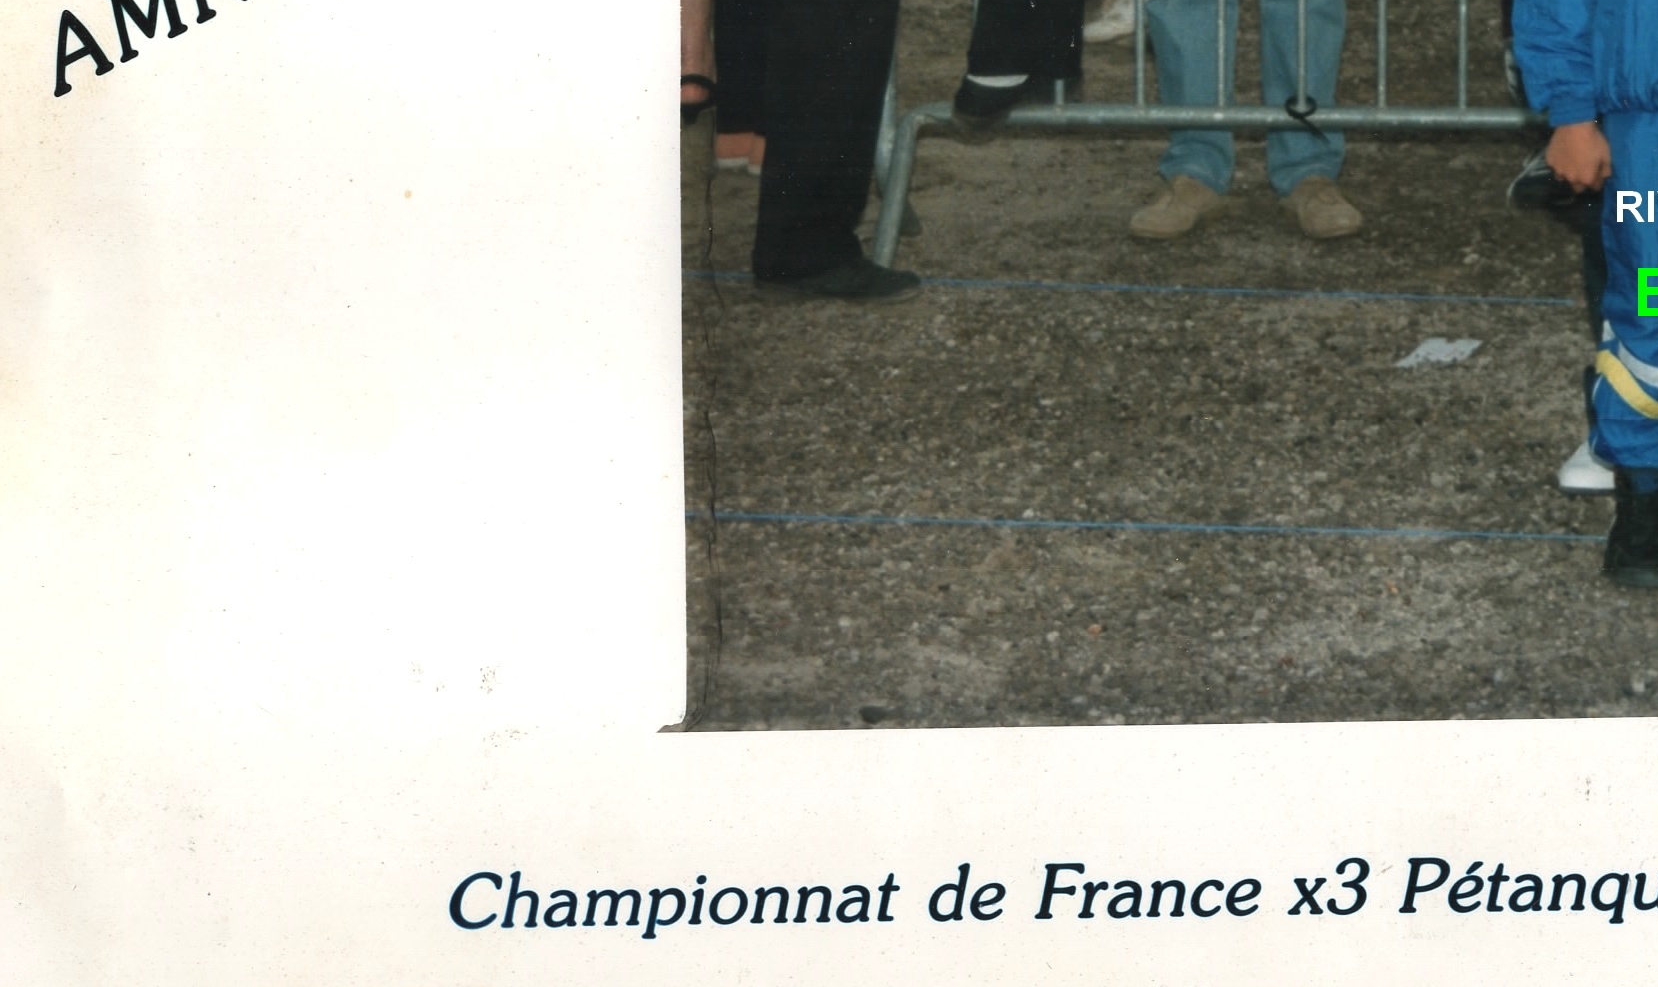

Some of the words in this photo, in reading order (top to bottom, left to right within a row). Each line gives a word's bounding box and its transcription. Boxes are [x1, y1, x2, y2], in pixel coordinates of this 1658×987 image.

[449, 870, 901, 940] Championnat
[928, 862, 1006, 922] de
[1034, 862, 1262, 920] France
[1287, 857, 1370, 916] x3
